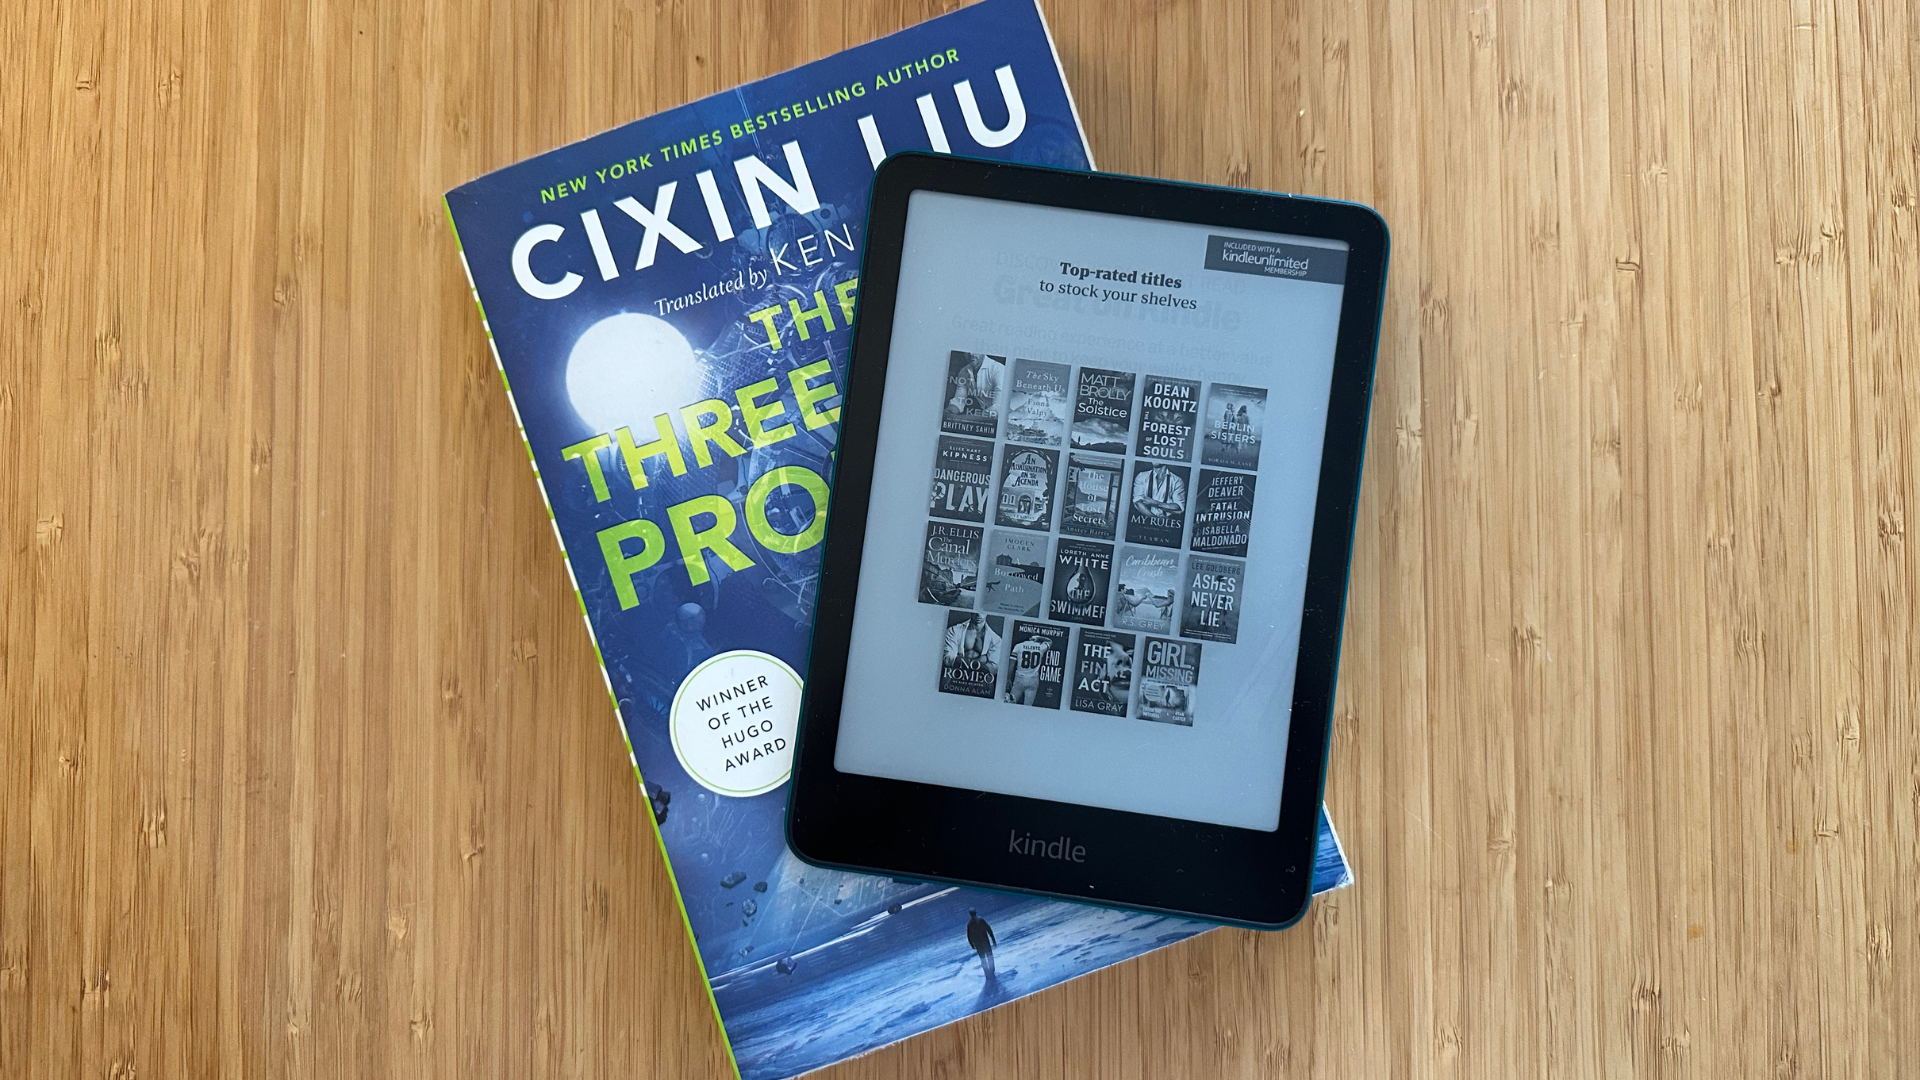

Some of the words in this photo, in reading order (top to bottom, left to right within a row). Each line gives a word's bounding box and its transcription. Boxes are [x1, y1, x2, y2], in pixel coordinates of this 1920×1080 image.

[541, 176, 587, 203] NEW
[596, 153, 653, 183] YORK
[661, 130, 722, 161] TIMES
[730, 82, 866, 139] BESTSELLING
[875, 48, 959, 90] AUTHOR
[511, 140, 821, 300] CIXIN
[1224, 241, 1256, 251] INCLUDED
[1257, 246, 1275, 254] WITH
[1222, 249, 1309, 270] kindleunlimited
[655, 271, 744, 316] Translated
[750, 267, 767, 289] by
[770, 223, 854, 275] KEN
[1060, 262, 1137, 283] Top-rated
[1141, 272, 1182, 289] titles
[1264, 266, 1307, 277] MEMBERSHIP
[1040, 279, 1054, 293] to
[1058, 283, 1099, 298] stock
[1102, 289, 1137, 302] your
[1141, 292, 1197, 310] shelves
[952, 314, 995, 334] Great
[999, 324, 1057, 343] reading
[1060, 331, 1145, 351] experience
[950, 376, 975, 387] NOT
[1026, 371, 1041, 380] The
[1043, 373, 1059, 383] Sky
[1081, 373, 1120, 388] MATT
[967, 388, 997, 399] MINE
[1016, 380, 1051, 391] Beneath
[1055, 385, 1066, 393] Us
[1080, 385, 1131, 401] BROLLY
[1155, 383, 1190, 399] DEAN
[958, 397, 973, 406] TO
[1088, 397, 1104, 407] The
[1144, 396, 1197, 413] KOONTZ
[966, 408, 997, 419] KEEP
[1078, 402, 1127, 418] Solstice
[561, 359, 842, 503] THREE
[943, 422, 974, 432] BRITTNEY
[976, 426, 995, 434] SAHIN
[1143, 421, 1191, 437] FOREST
[1214, 420, 1255, 433] BERLIN
[1153, 435, 1185, 448] LOST
[1211, 431, 1256, 444] SISTERS
[943, 451, 988, 462] KIPNESS
[1143, 445, 1184, 460] SOULS
[935, 468, 991, 486] DANGEROUS
[1087, 471, 1105, 481] The
[1212, 476, 1244, 487] JEFFERY
[1079, 480, 1108, 492] House
[1208, 486, 1244, 498] DEAVER
[930, 481, 989, 515] PLAY
[1087, 494, 1097, 502] of
[1081, 504, 1102, 515] Lost
[1210, 501, 1239, 512] FATAL
[1073, 512, 1107, 526] Secrets
[1131, 514, 1148, 525] MY
[1150, 516, 1181, 529] RULES
[1196, 510, 1250, 522] INTRUSION
[596, 451, 835, 611] PRO
[931, 526, 949, 537] J.R.
[950, 527, 980, 539] ELLIS
[1202, 524, 1240, 535] ISABELLA
[928, 536, 970, 555] Canal
[1193, 533, 1247, 547] MALDONADO
[927, 550, 977, 566] Murders
[1059, 555, 1109, 570] WHITE
[995, 568, 1039, 581] Borrowed
[1192, 562, 1203, 570] LEE
[1206, 563, 1241, 575] GOLDBERG
[1004, 584, 1024, 593] Path
[1192, 573, 1236, 593] ASHES
[1191, 591, 1234, 611] NEVER
[1051, 600, 1105, 619] SWIMMER
[1122, 618, 1137, 627] R.S.
[1139, 620, 1165, 630] GREY
[1200, 611, 1220, 627] LIE
[1019, 626, 1040, 635] MONICA
[1041, 629, 1064, 637] MURPHY
[1046, 650, 1060, 666] END
[1084, 644, 1111, 659] THE
[1147, 641, 1194, 671] GIRL,
[961, 659, 980, 671] NO
[1021, 651, 1041, 669] 80
[944, 667, 995, 684] ROMEO
[1040, 666, 1061, 683] GAME
[1146, 665, 1194, 684] MISSING
[696, 675, 768, 711] WINNER
[944, 684, 971, 694] DONNA
[972, 687, 991, 696] ALAM
[1078, 678, 1109, 693] ACT
[708, 712, 731, 730] OF
[738, 696, 773, 718] THE
[1076, 699, 1095, 709] LISA
[1098, 702, 1124, 712] GRAY
[722, 720, 772, 748] HUGO
[725, 738, 786, 771] AWARD
[1009, 829, 1086, 863] kindle
